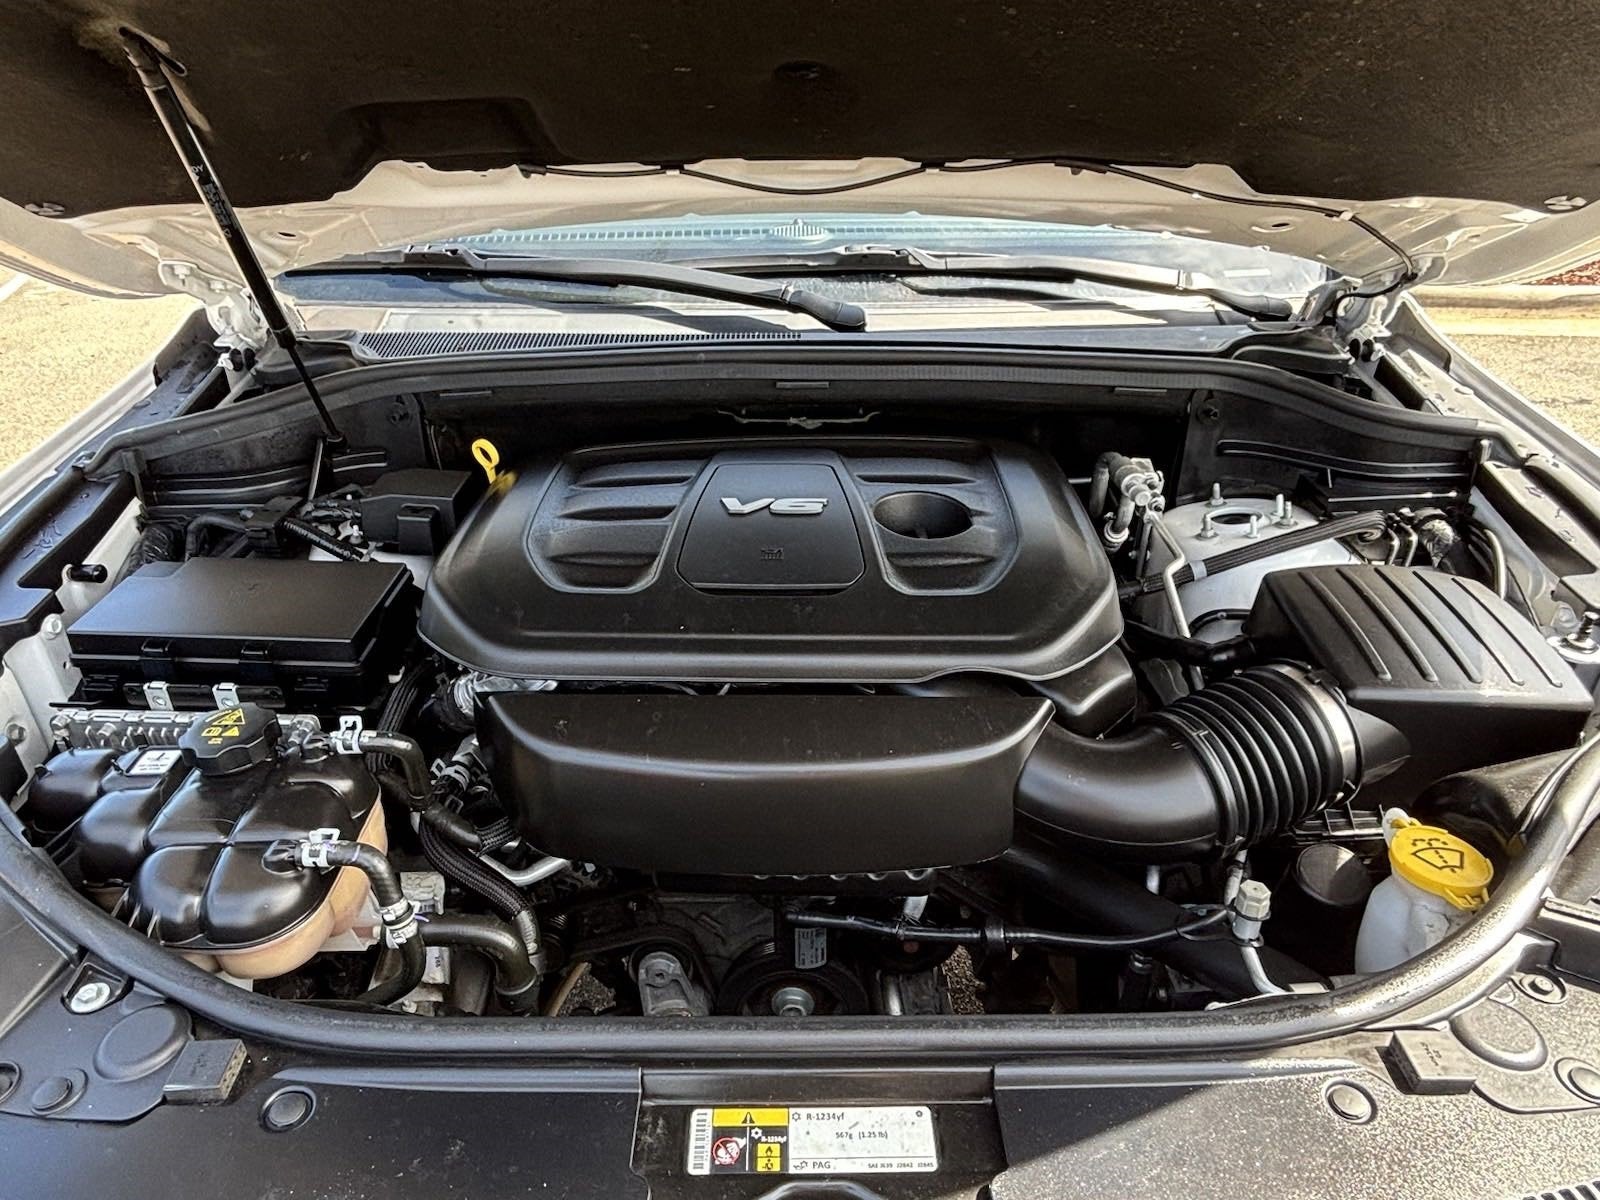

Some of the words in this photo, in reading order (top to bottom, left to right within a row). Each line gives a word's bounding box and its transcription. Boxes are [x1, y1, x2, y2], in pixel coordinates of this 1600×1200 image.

[720, 497, 829, 515] V6
[806, 1112, 845, 1121] R-1234yf
[835, 1131, 853, 1140] 567g
[858, 1131, 877, 1140] (1.25
[812, 1161, 831, 1169] PAG
